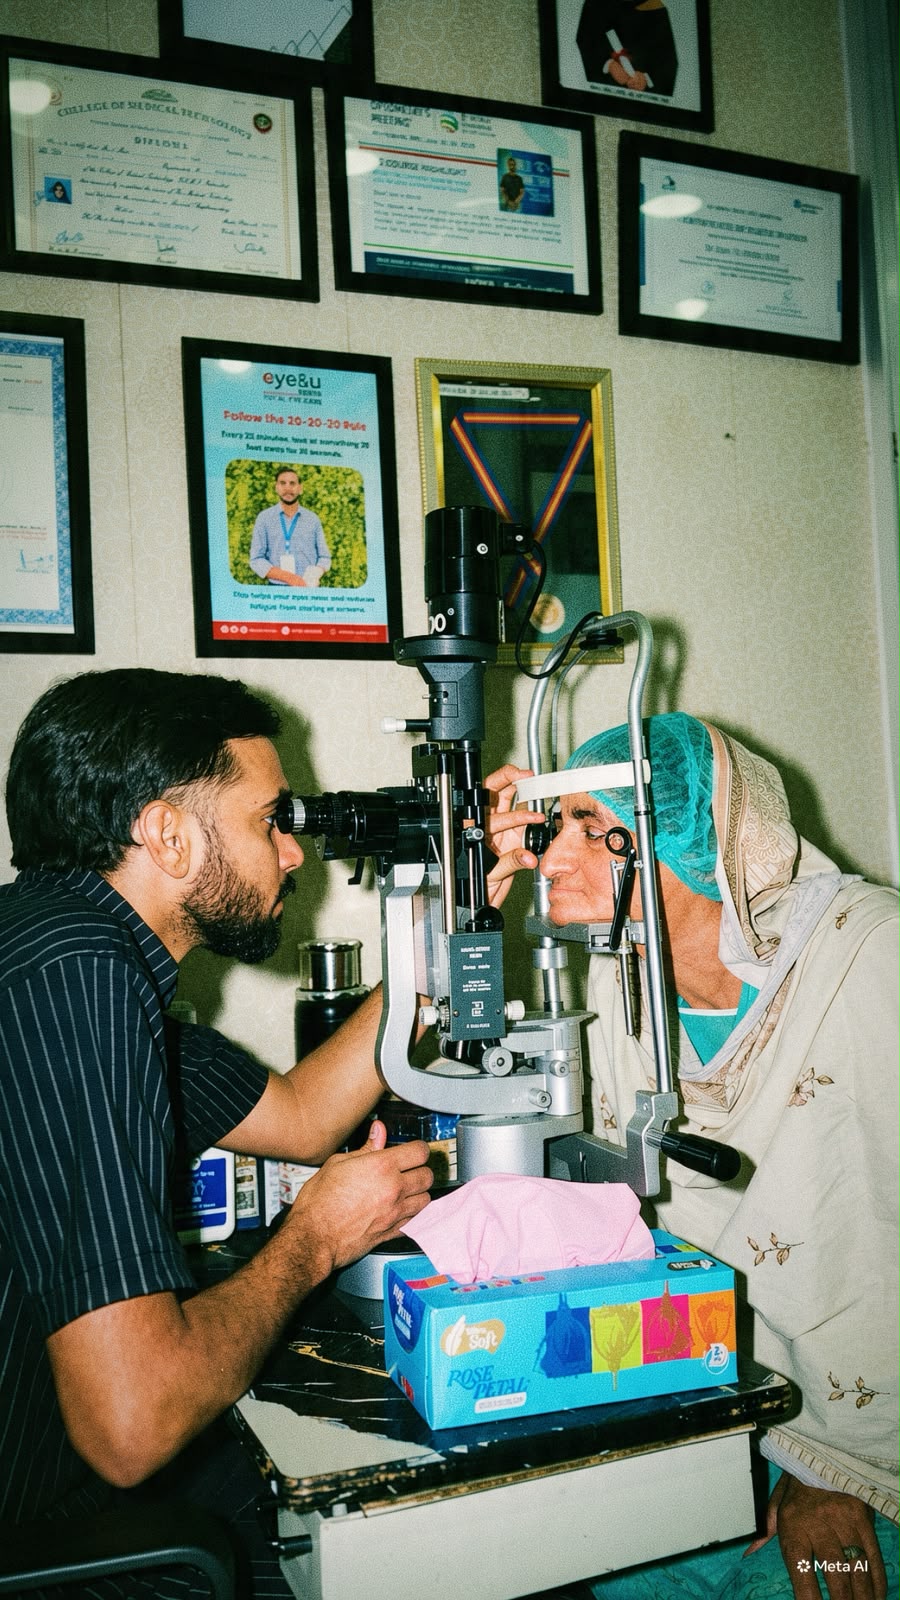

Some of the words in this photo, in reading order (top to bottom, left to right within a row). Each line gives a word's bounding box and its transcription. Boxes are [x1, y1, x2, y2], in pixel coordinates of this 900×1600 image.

[262, 372, 321, 390] eye&u
[223, 410, 263, 423] Follow
[265, 413, 285, 424] the
[287, 415, 341, 429] 20-20-20
[343, 420, 367, 431] Rule
[468, 1330, 498, 1350] Soft
[447, 1364, 494, 1390] ROSE
[473, 1377, 530, 1400] PETAL
